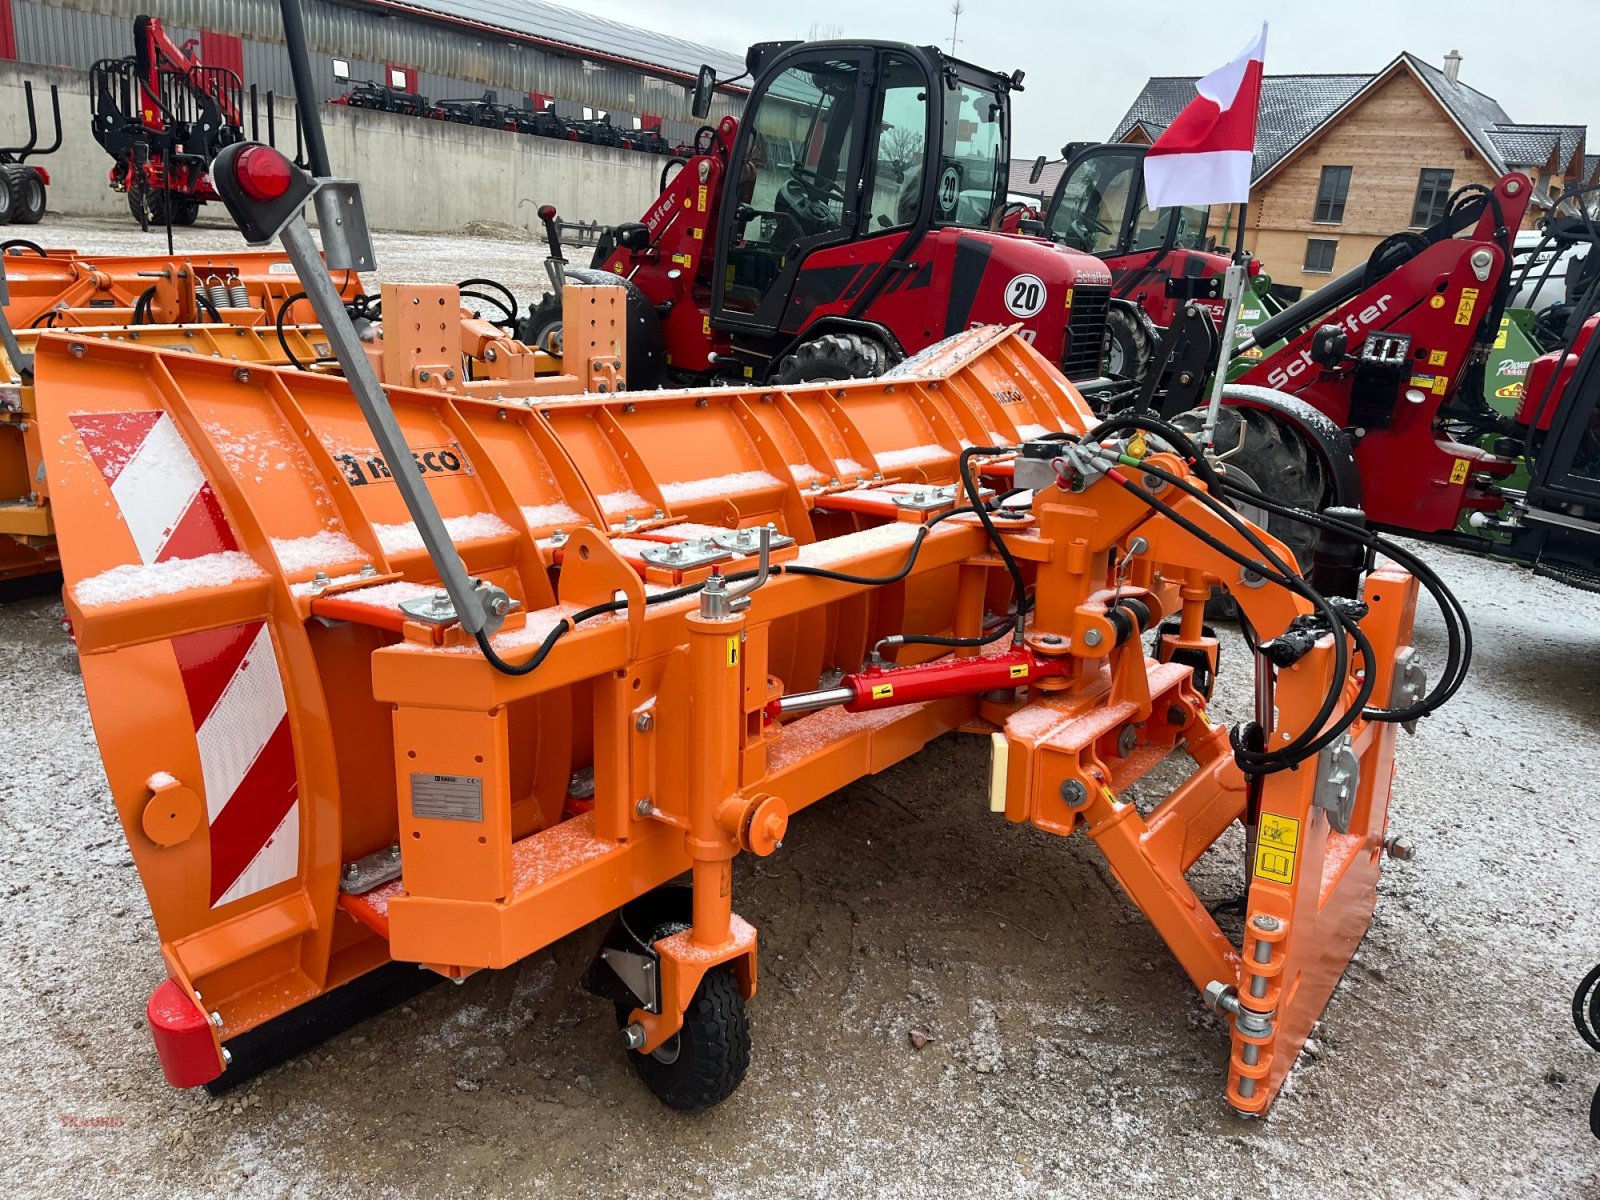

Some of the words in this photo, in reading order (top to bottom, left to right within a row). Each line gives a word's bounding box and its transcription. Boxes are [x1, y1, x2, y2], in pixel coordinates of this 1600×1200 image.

[943, 175, 956, 204] 20
[1011, 281, 1040, 311] 20
[365, 450, 461, 479] RSCO
